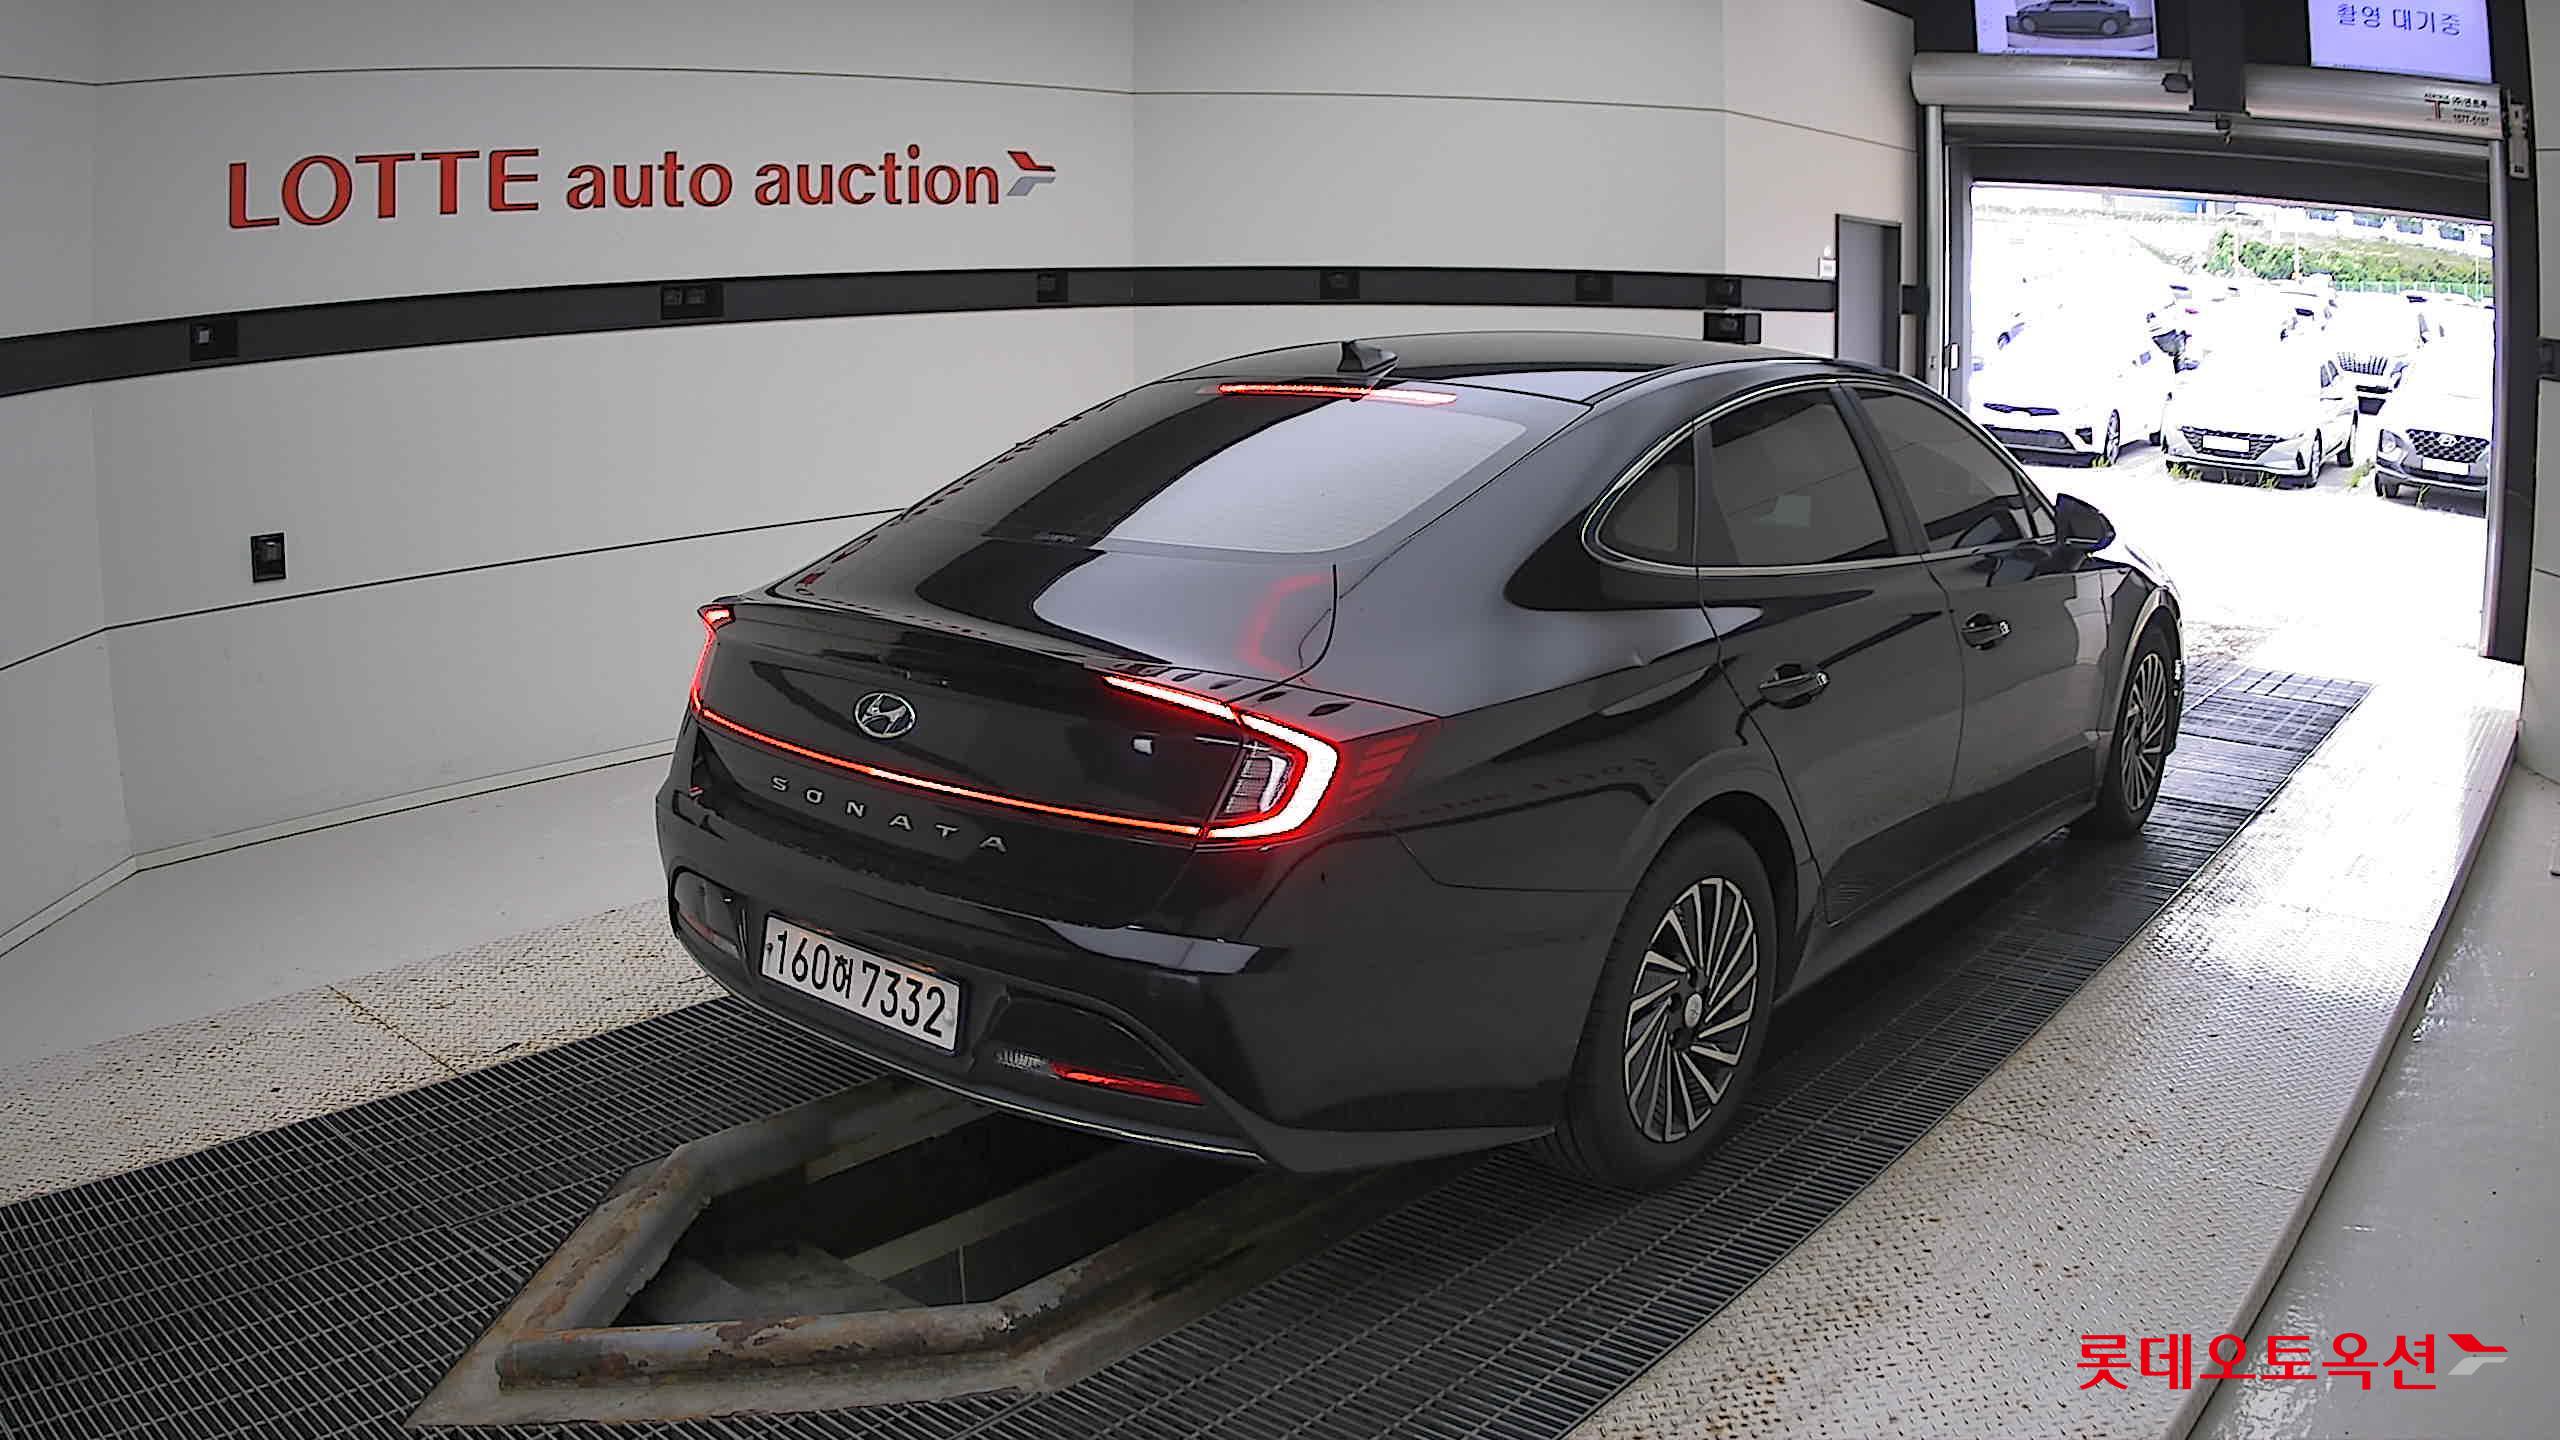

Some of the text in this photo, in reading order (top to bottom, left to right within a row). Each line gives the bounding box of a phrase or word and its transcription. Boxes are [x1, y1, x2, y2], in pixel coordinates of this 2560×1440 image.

[2392, 8, 2461, 36] 대기중
[228, 143, 1000, 229] LOTTE auto auction
[771, 776, 1008, 853] SONATA
